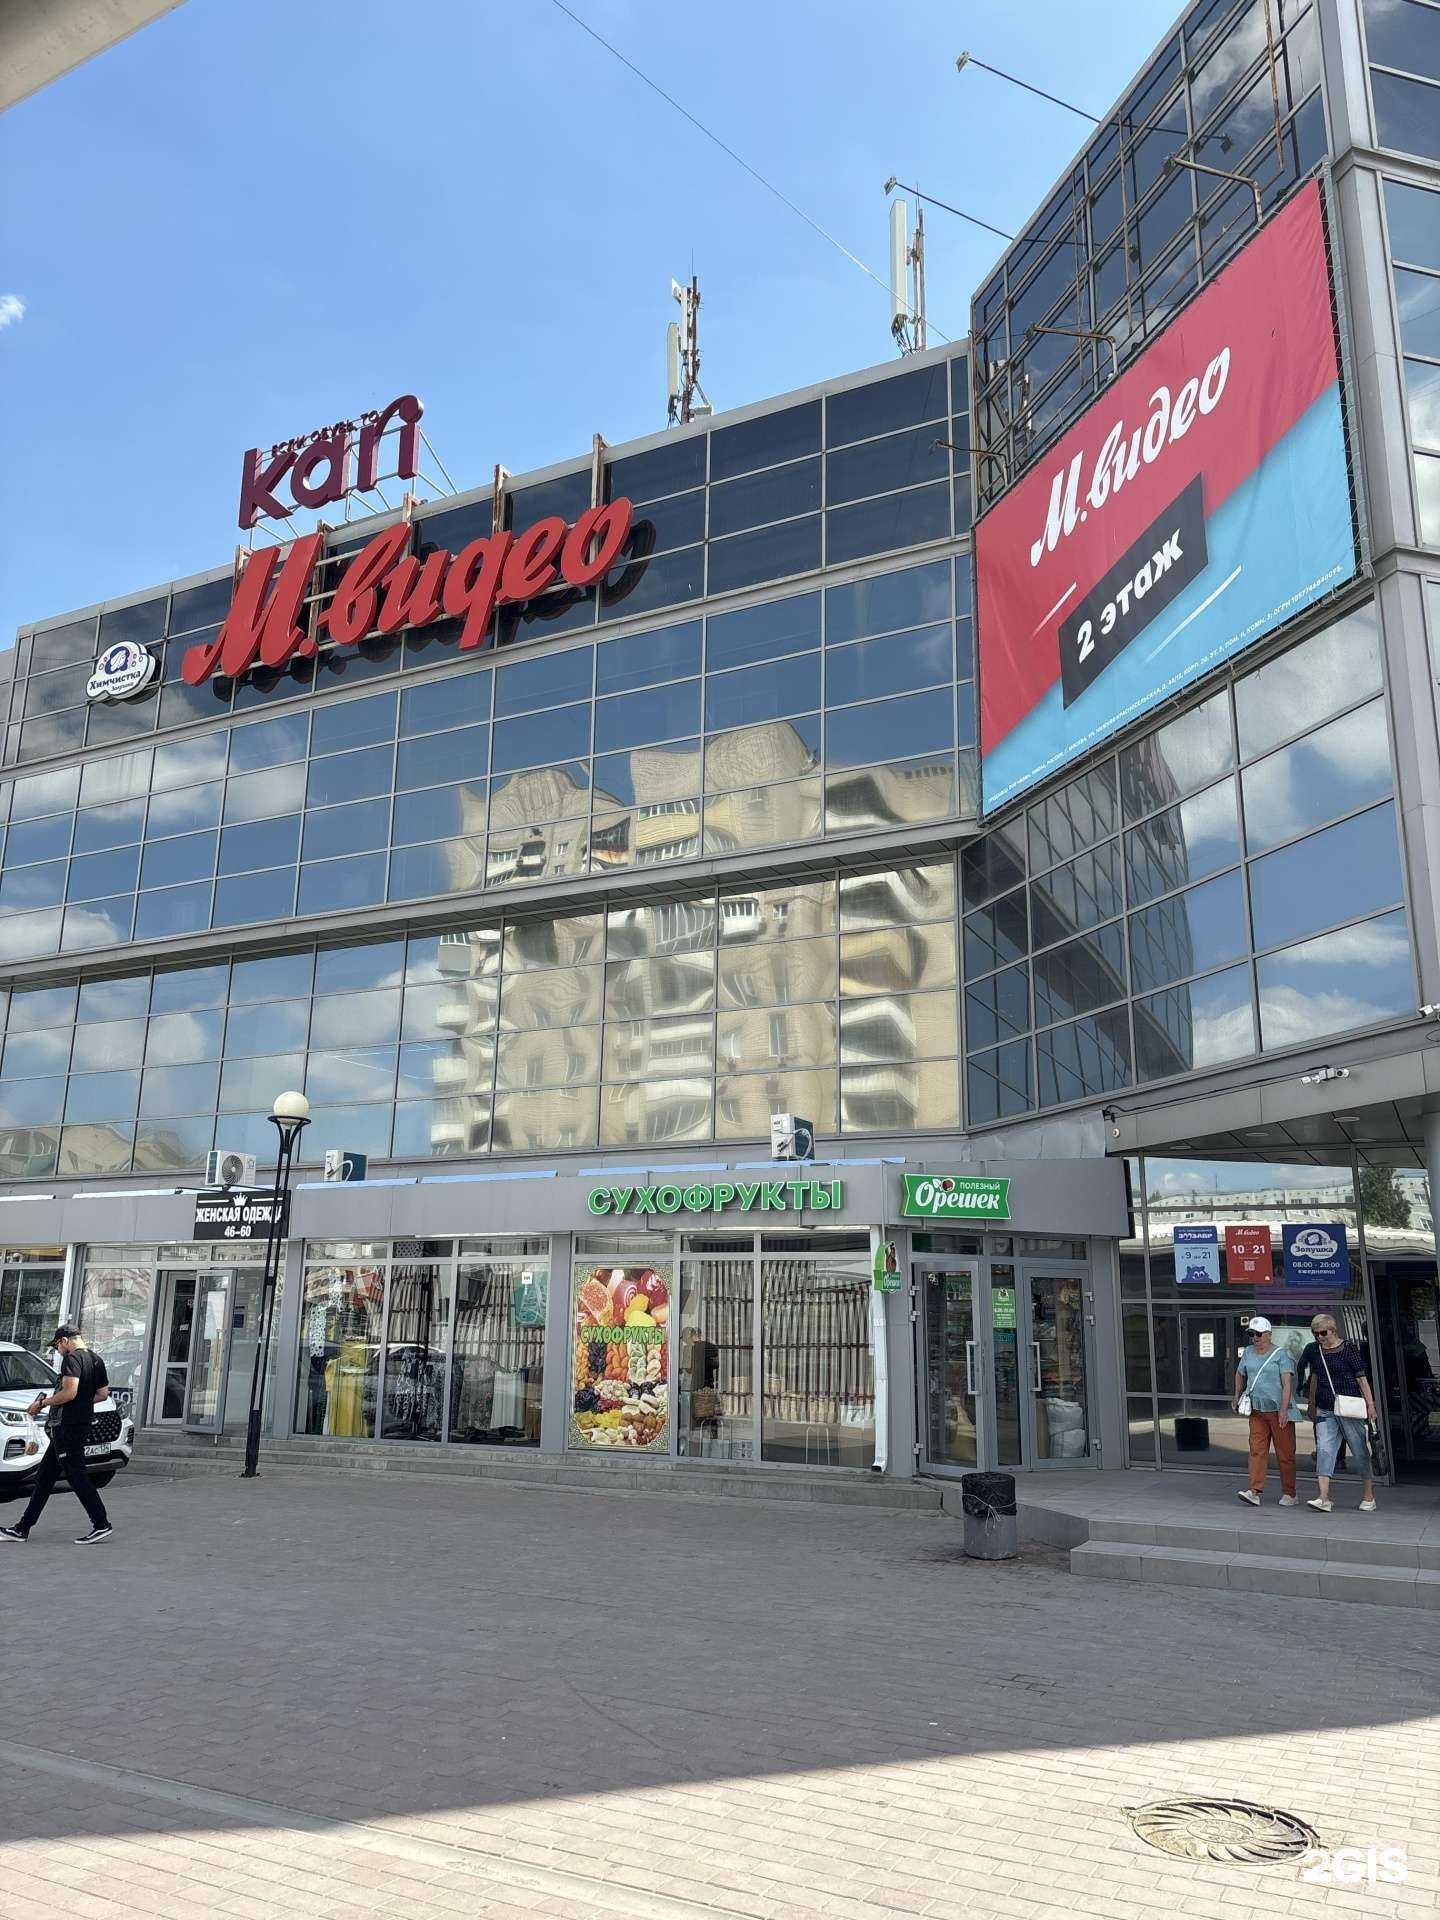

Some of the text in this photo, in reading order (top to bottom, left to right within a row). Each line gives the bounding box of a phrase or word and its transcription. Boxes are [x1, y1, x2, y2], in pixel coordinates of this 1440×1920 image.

[238, 395, 424, 530] kari
[1030, 346, 1231, 567] М.видео
[181, 496, 634, 687] М.видео
[1076, 528, 1184, 664] 2 этаж
[89, 670, 141, 691] Химчистка
[587, 1179, 842, 1215] СУХОФРУКТЫ
[915, 1180, 1000, 1213] Орешек
[959, 1181, 1000, 1191] ПОЛЕЗНЫЙ
[195, 1207, 240, 1223] ЖЕНСКАЯ
[1185, 1251, 1192, 1259] 9
[1202, 1251, 1211, 1259] 21
[1231, 1244, 1265, 1254] 10 21
[580, 1325, 667, 1345] СУХОФРУКТЫ
